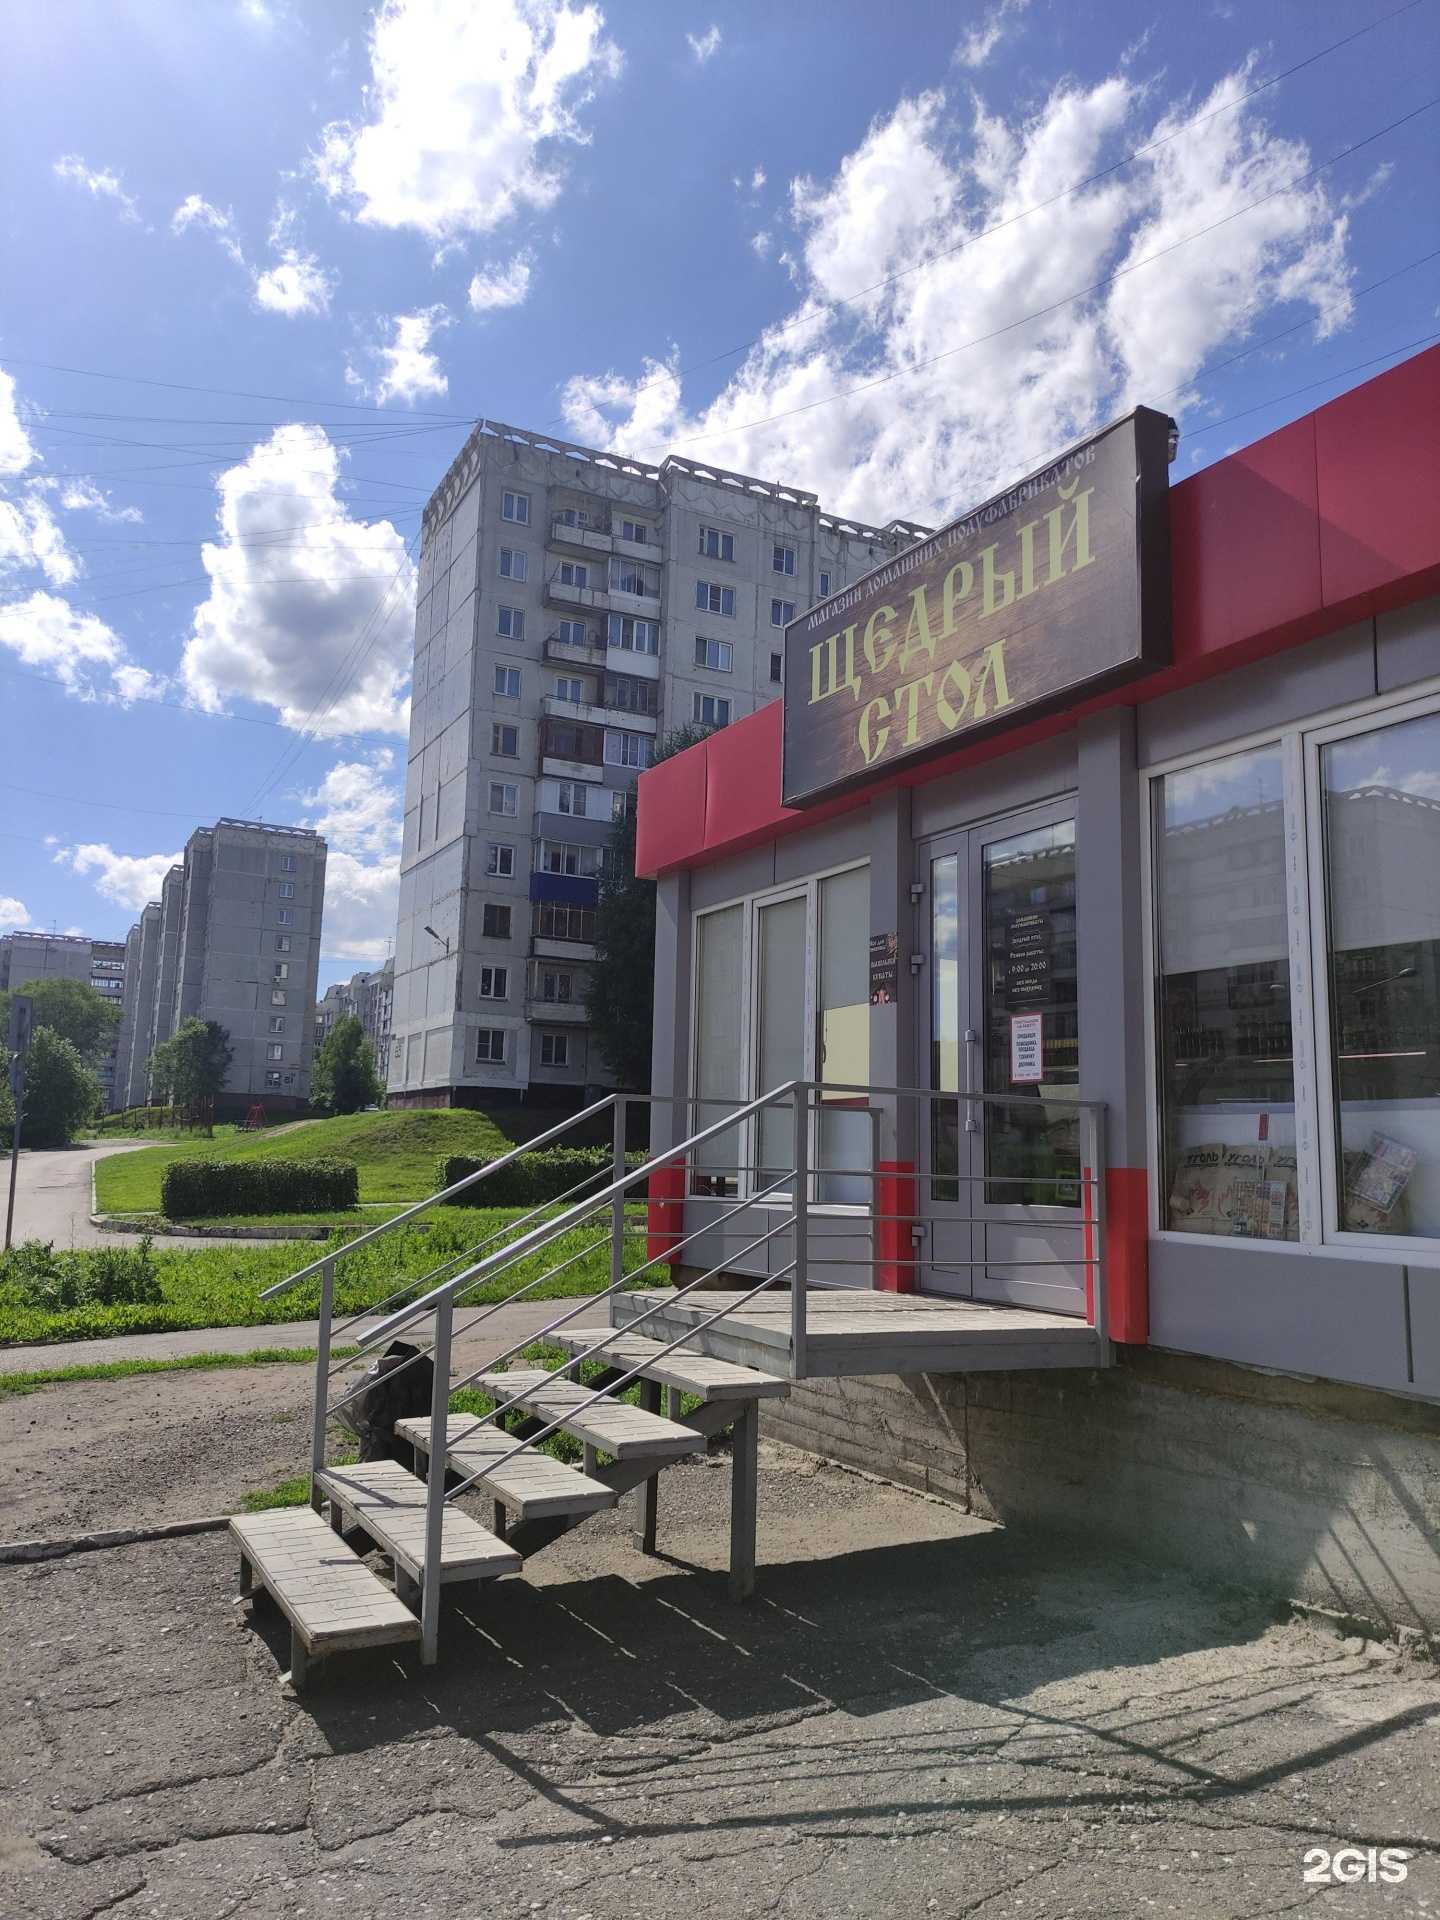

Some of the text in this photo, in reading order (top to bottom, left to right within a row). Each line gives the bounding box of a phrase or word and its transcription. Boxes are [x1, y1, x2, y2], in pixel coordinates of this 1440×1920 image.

[807, 477, 1096, 705] ЩЕДРЫЙ
[808, 445, 1096, 631] МАГАЗИН ДОМАШНИХ ПОЛУФАБРИКАТОВ
[858, 638, 1015, 764] СТОЛ
